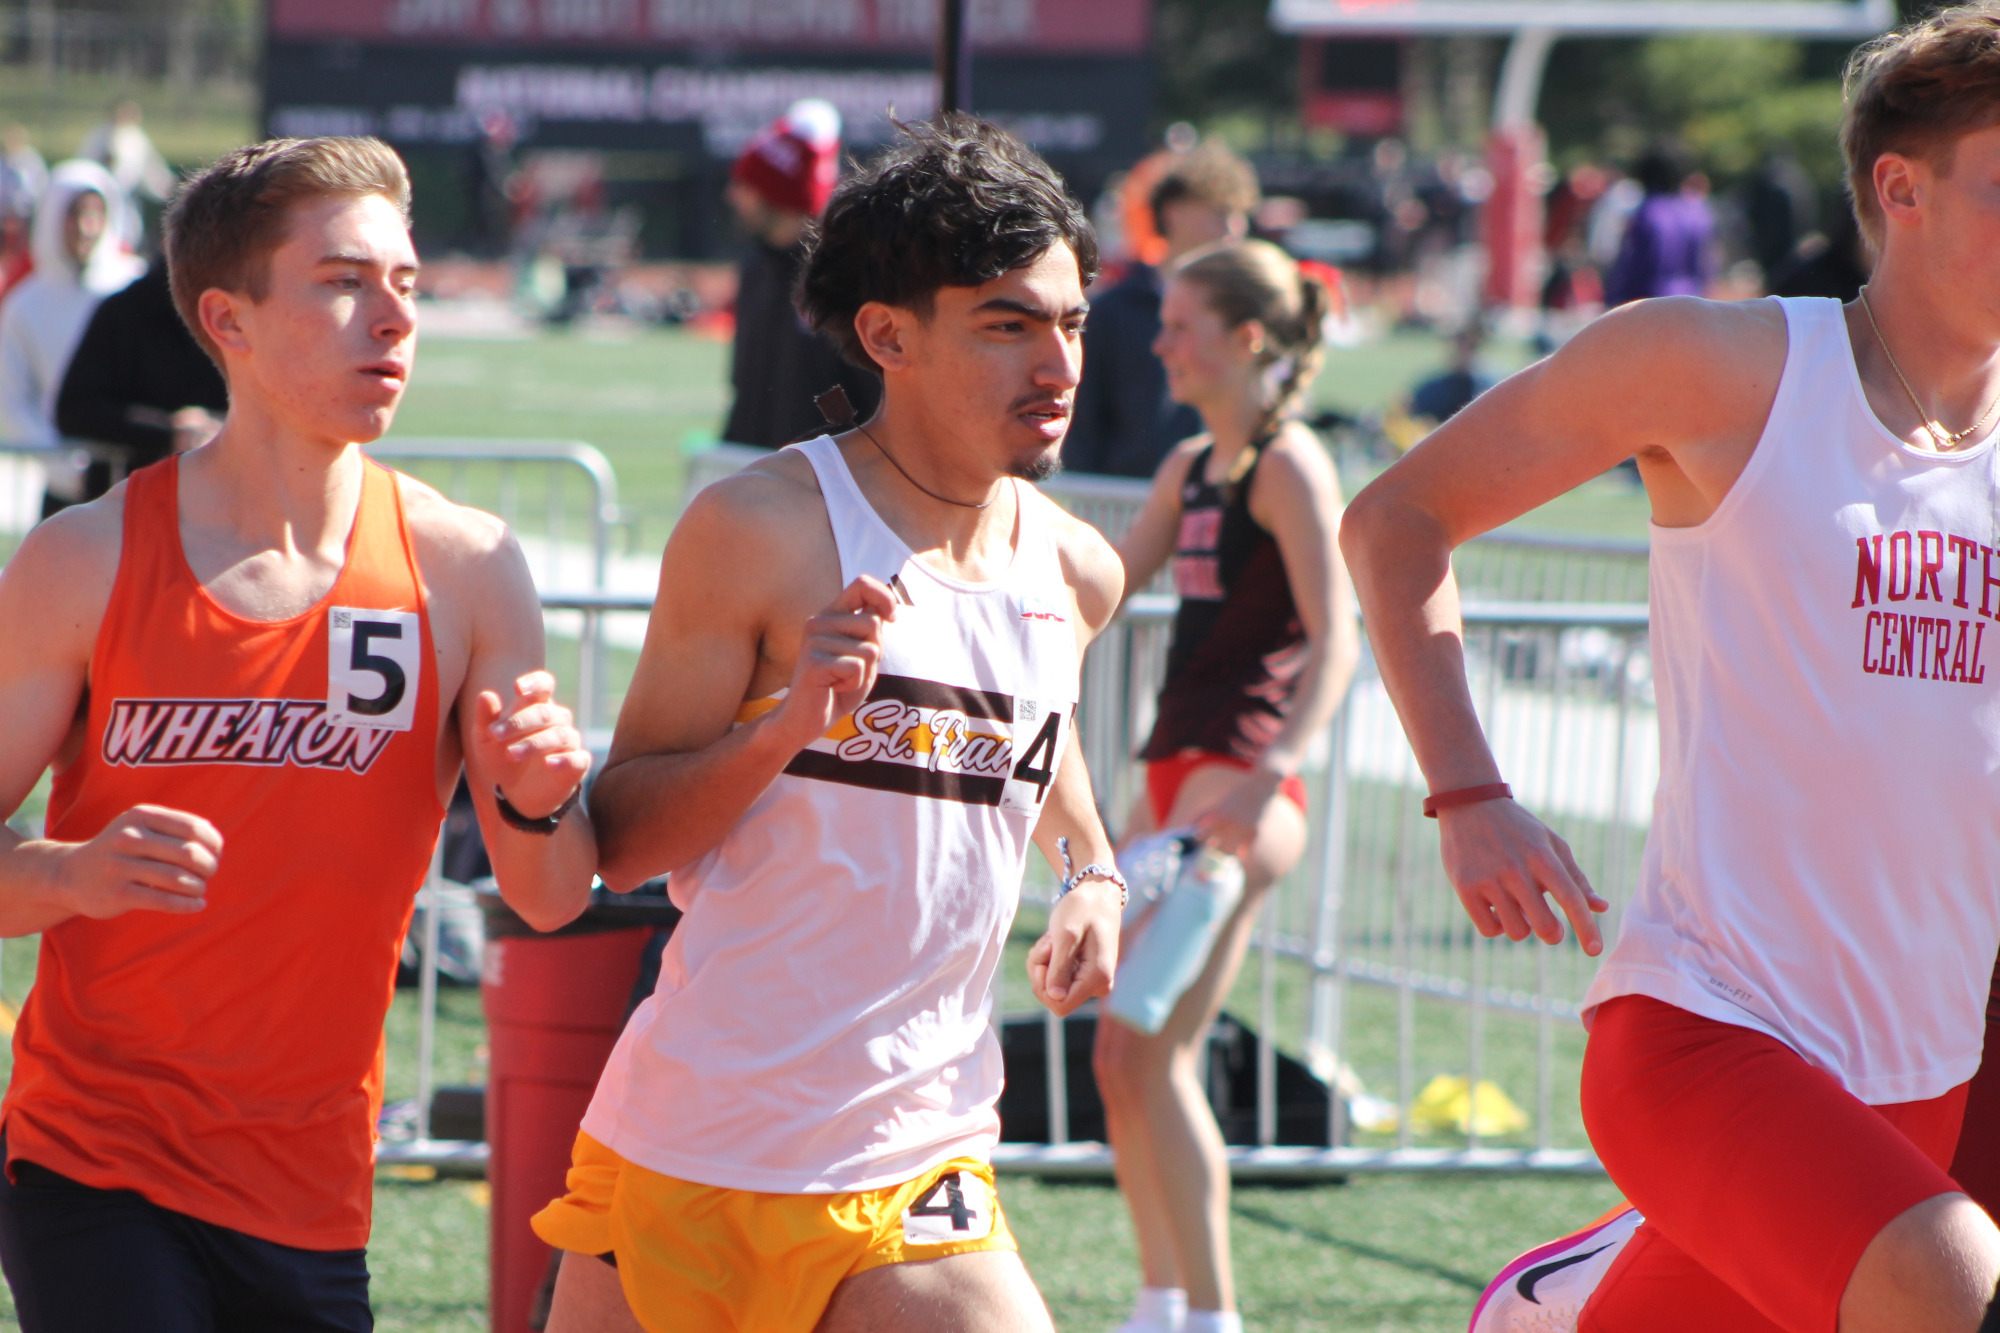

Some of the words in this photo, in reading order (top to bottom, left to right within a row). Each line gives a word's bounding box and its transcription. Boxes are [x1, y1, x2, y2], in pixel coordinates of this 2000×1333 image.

[1851, 530, 2000, 622] NORTH
[347, 620, 406, 716] 5
[1863, 611, 1985, 684] CENTRAL
[103, 699, 395, 775] WHEATON
[837, 699, 920, 762] St.
[1012, 711, 1061, 804] 4
[908, 1171, 977, 1231] 4
